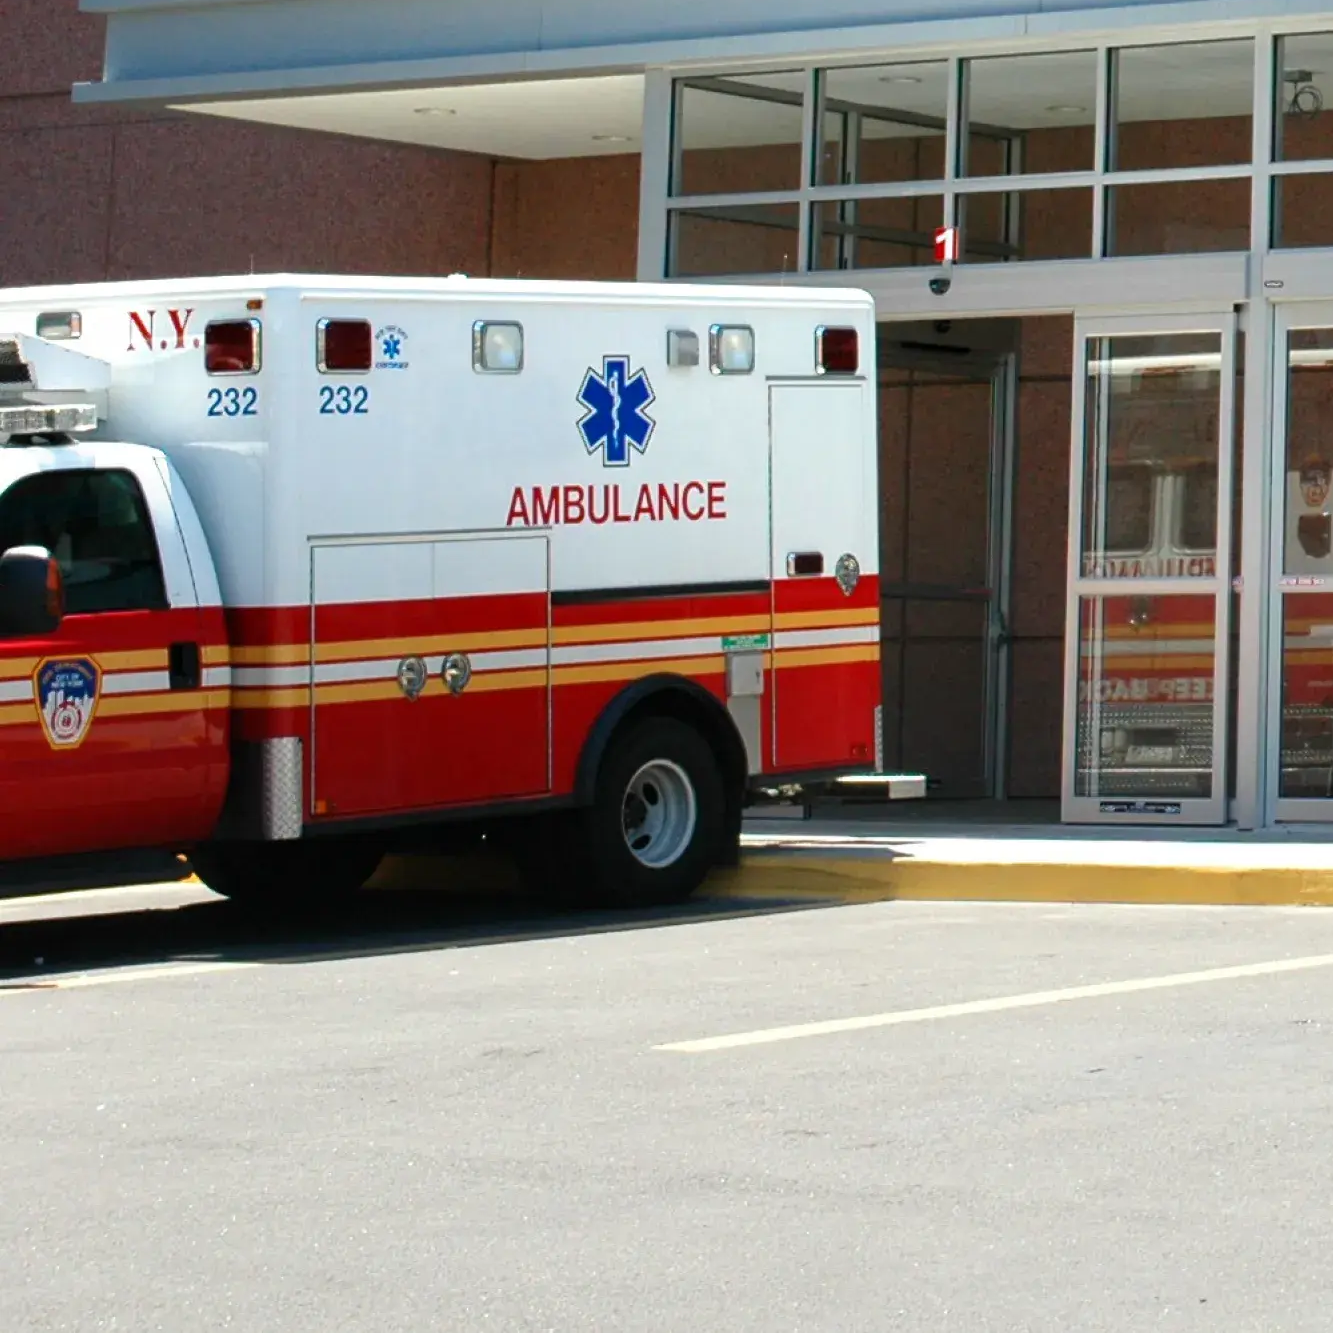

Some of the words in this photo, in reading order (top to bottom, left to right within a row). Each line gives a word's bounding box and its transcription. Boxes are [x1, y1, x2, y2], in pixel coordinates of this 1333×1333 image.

[935, 228, 954, 260] 1
[126, 308, 200, 351] N.Y.
[207, 387, 257, 417] 232
[319, 385, 369, 414] 232
[506, 481, 727, 526] AMBULANCE
